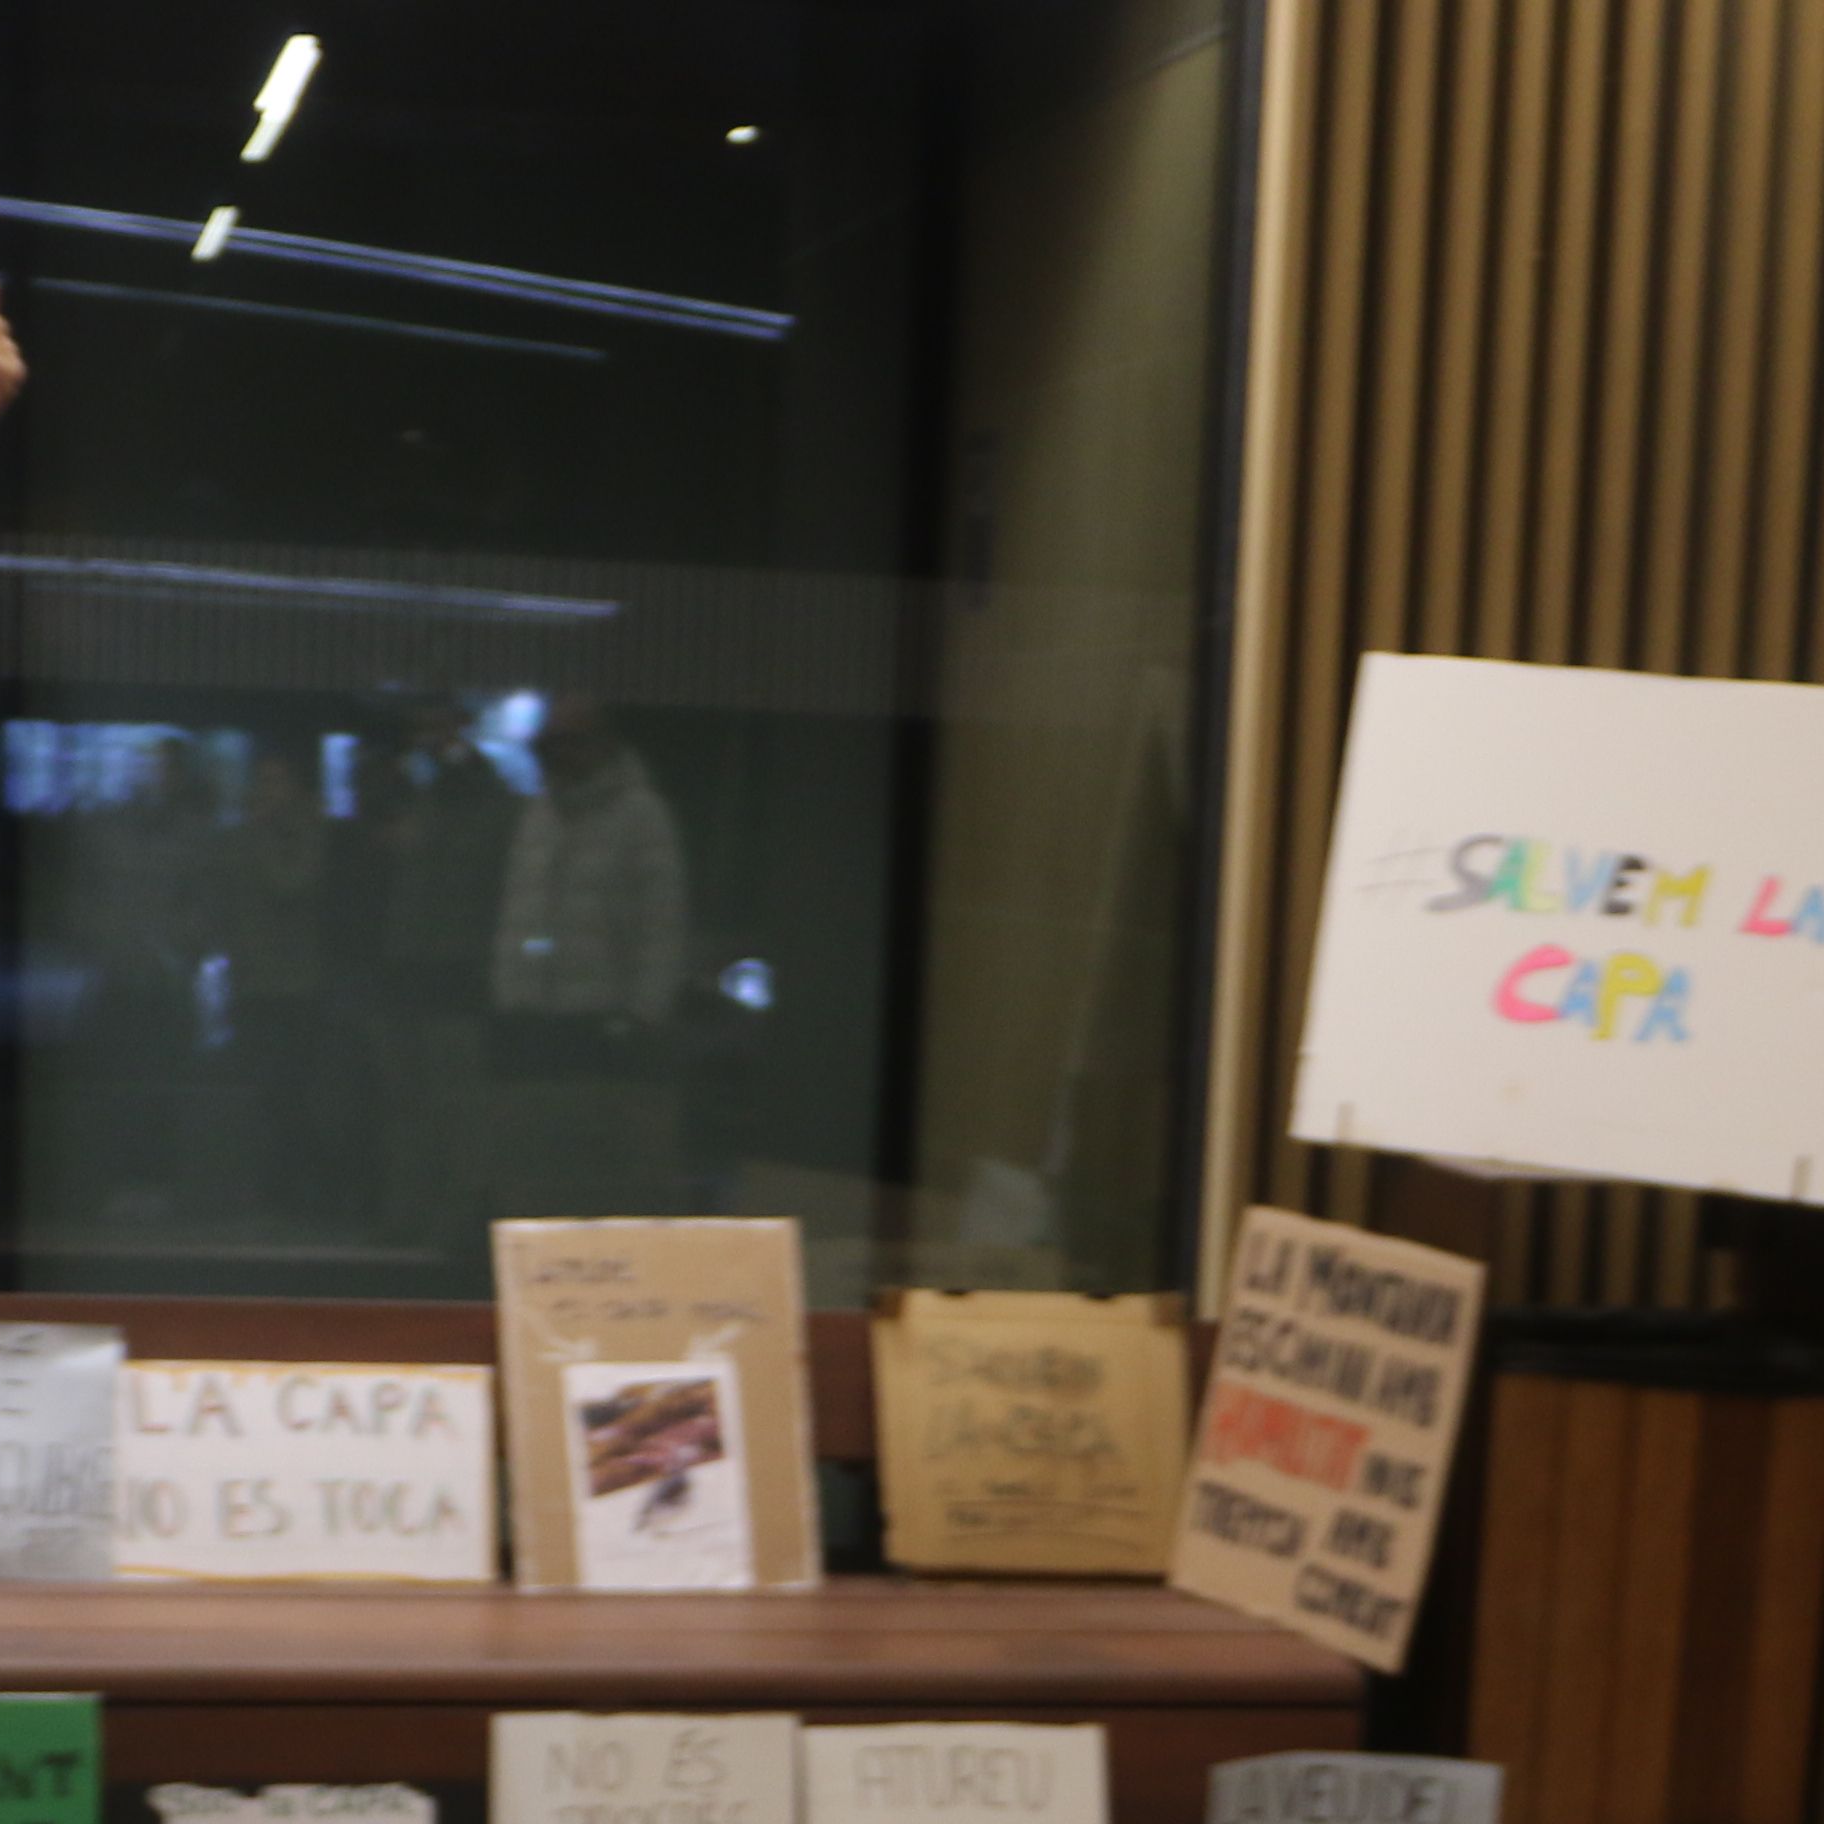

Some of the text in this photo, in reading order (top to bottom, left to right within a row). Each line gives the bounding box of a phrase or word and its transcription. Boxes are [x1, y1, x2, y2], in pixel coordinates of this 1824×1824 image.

[1426, 834, 1713, 927] SALVEM
[1492, 943, 1693, 1045] CAPA
[129, 1373, 462, 1438] LA CAPA
[217, 1478, 293, 1538] ES
[312, 1479, 470, 1537] TOCA
[544, 1741, 629, 1794] NO
